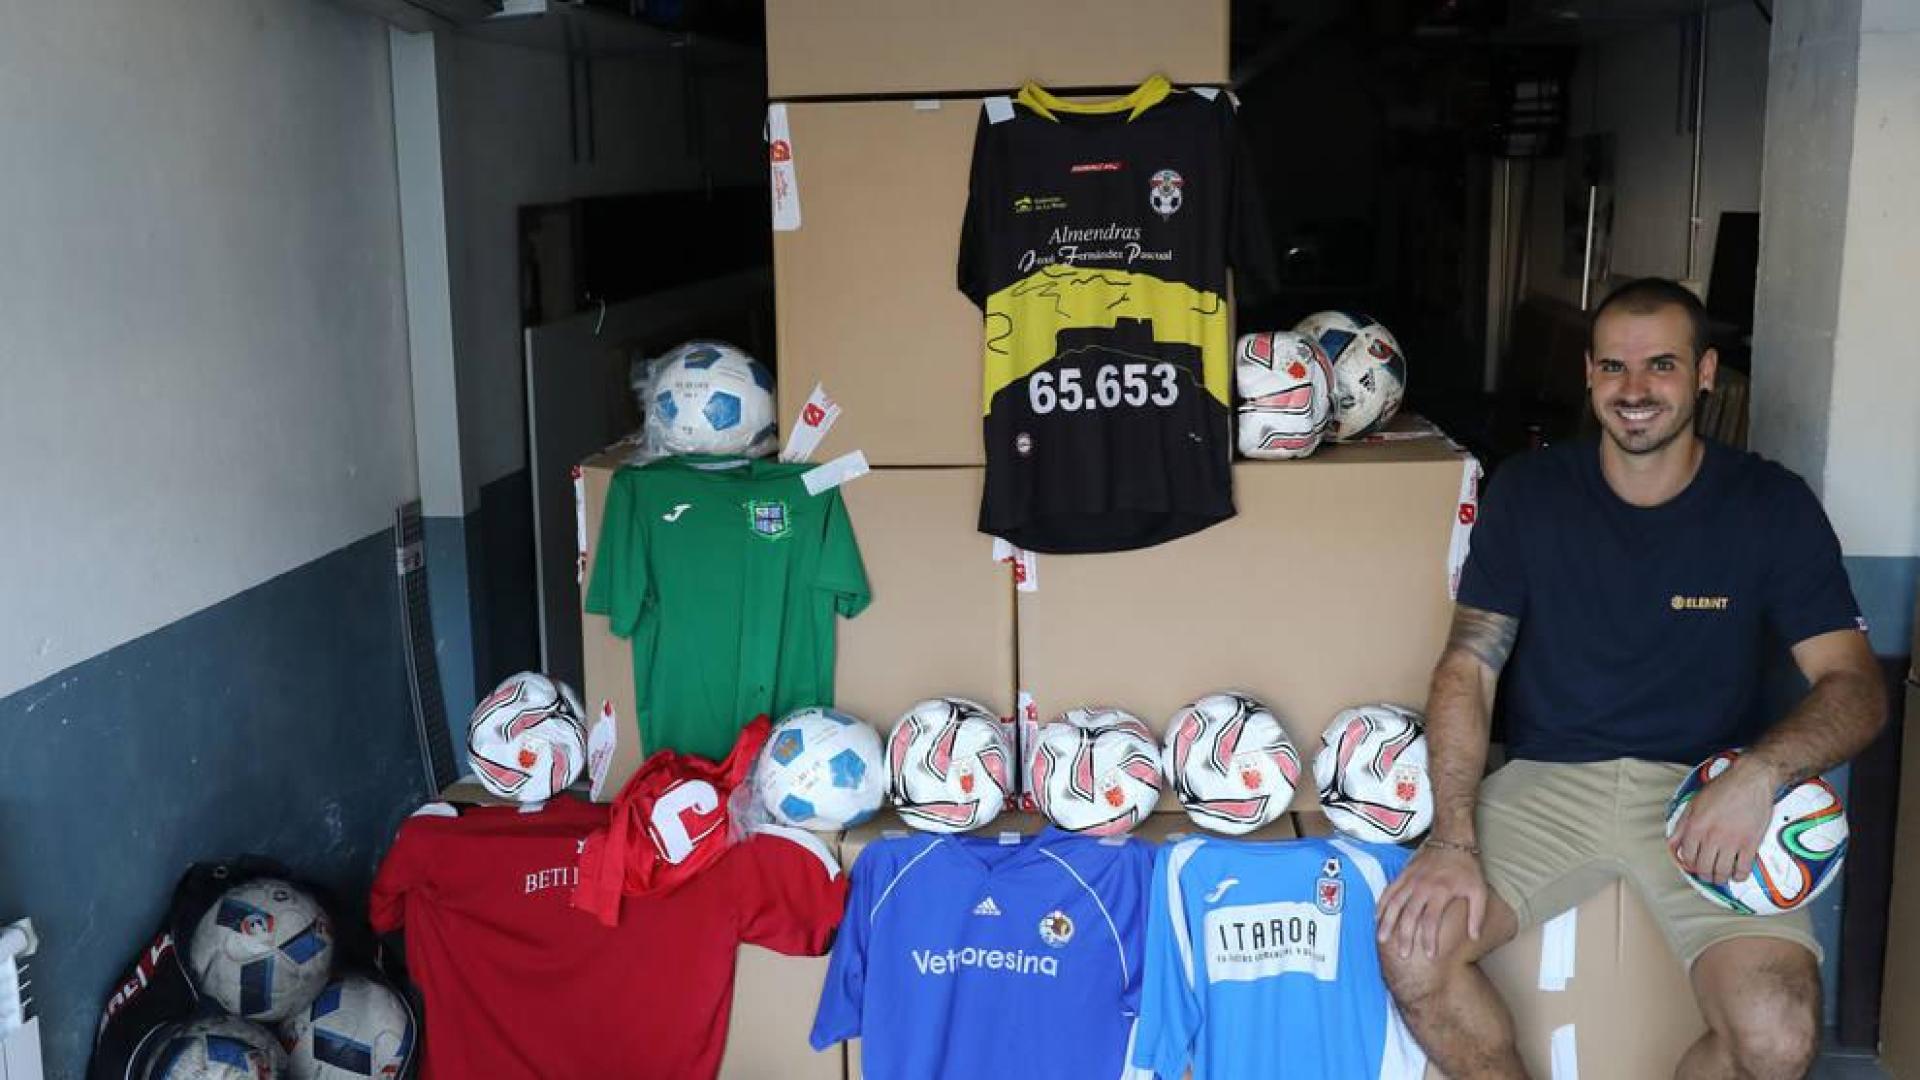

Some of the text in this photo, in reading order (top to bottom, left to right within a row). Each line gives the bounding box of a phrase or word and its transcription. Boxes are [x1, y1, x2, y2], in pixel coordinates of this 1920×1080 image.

[1049, 222, 1142, 245] Almendras
[1028, 362, 1180, 414] 65.653
[525, 867, 567, 894] BETI
[1219, 916, 1318, 951] ITAROA
